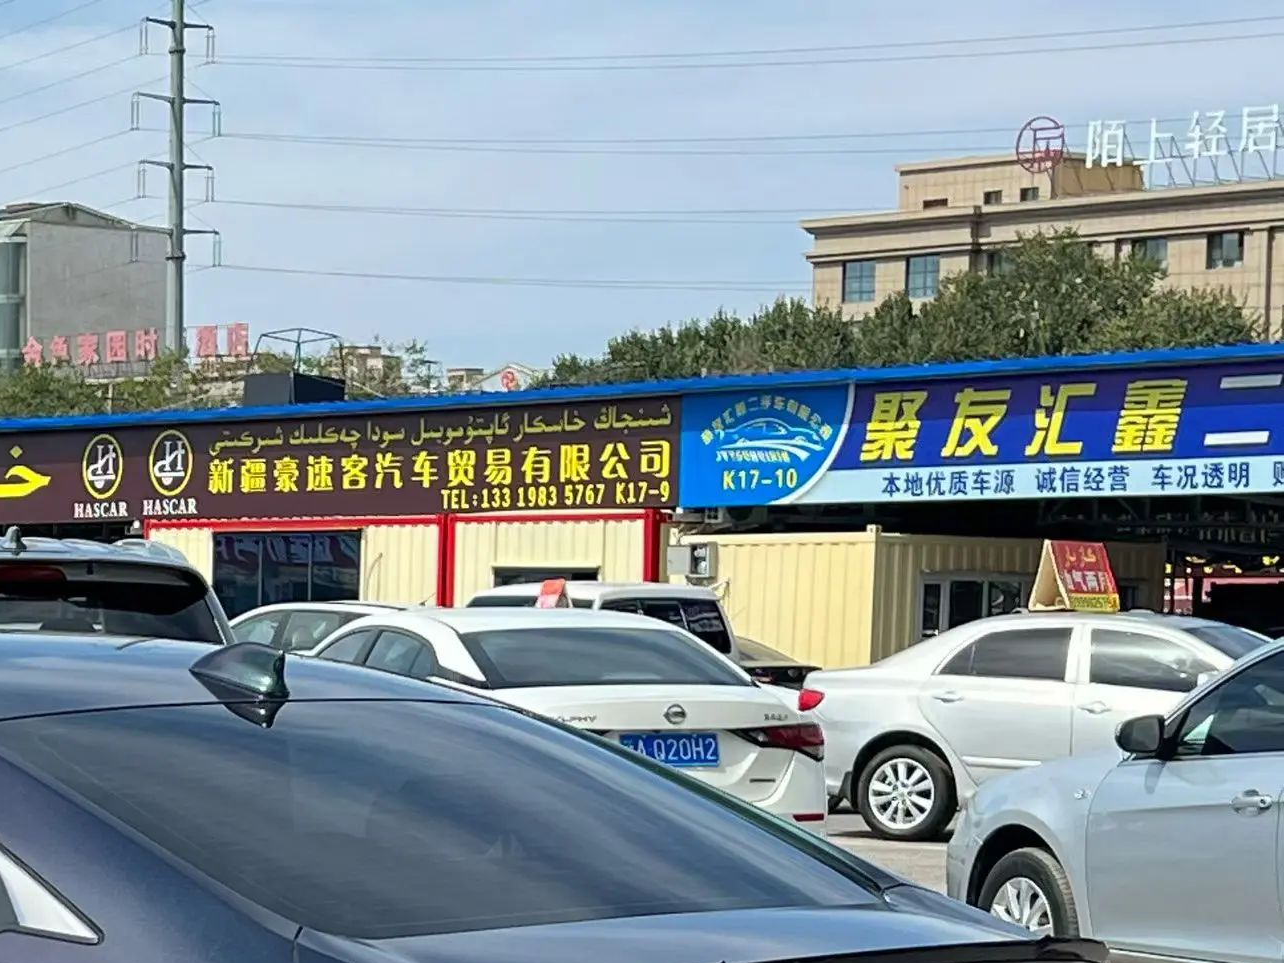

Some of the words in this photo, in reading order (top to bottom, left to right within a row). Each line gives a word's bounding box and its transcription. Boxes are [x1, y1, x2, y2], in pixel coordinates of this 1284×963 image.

[1085, 104, 1279, 170] 陌上轻居
[208, 439, 673, 494] 新疆豪速客汽车贸易有限公司
[723, 468, 798, 490] K17-10
[882, 469, 1016, 497] 本地优质车源
[1035, 466, 1131, 494] 诚信经营
[1151, 462, 1250, 491] 车况透明
[73, 502, 128, 519] HASCAR
[142, 498, 198, 516] HASCAR
[441, 487, 511, 511] TEL:133
[516, 485, 557, 508] 1983
[564, 483, 605, 505] 5767
[616, 480, 671, 503] K17-9
